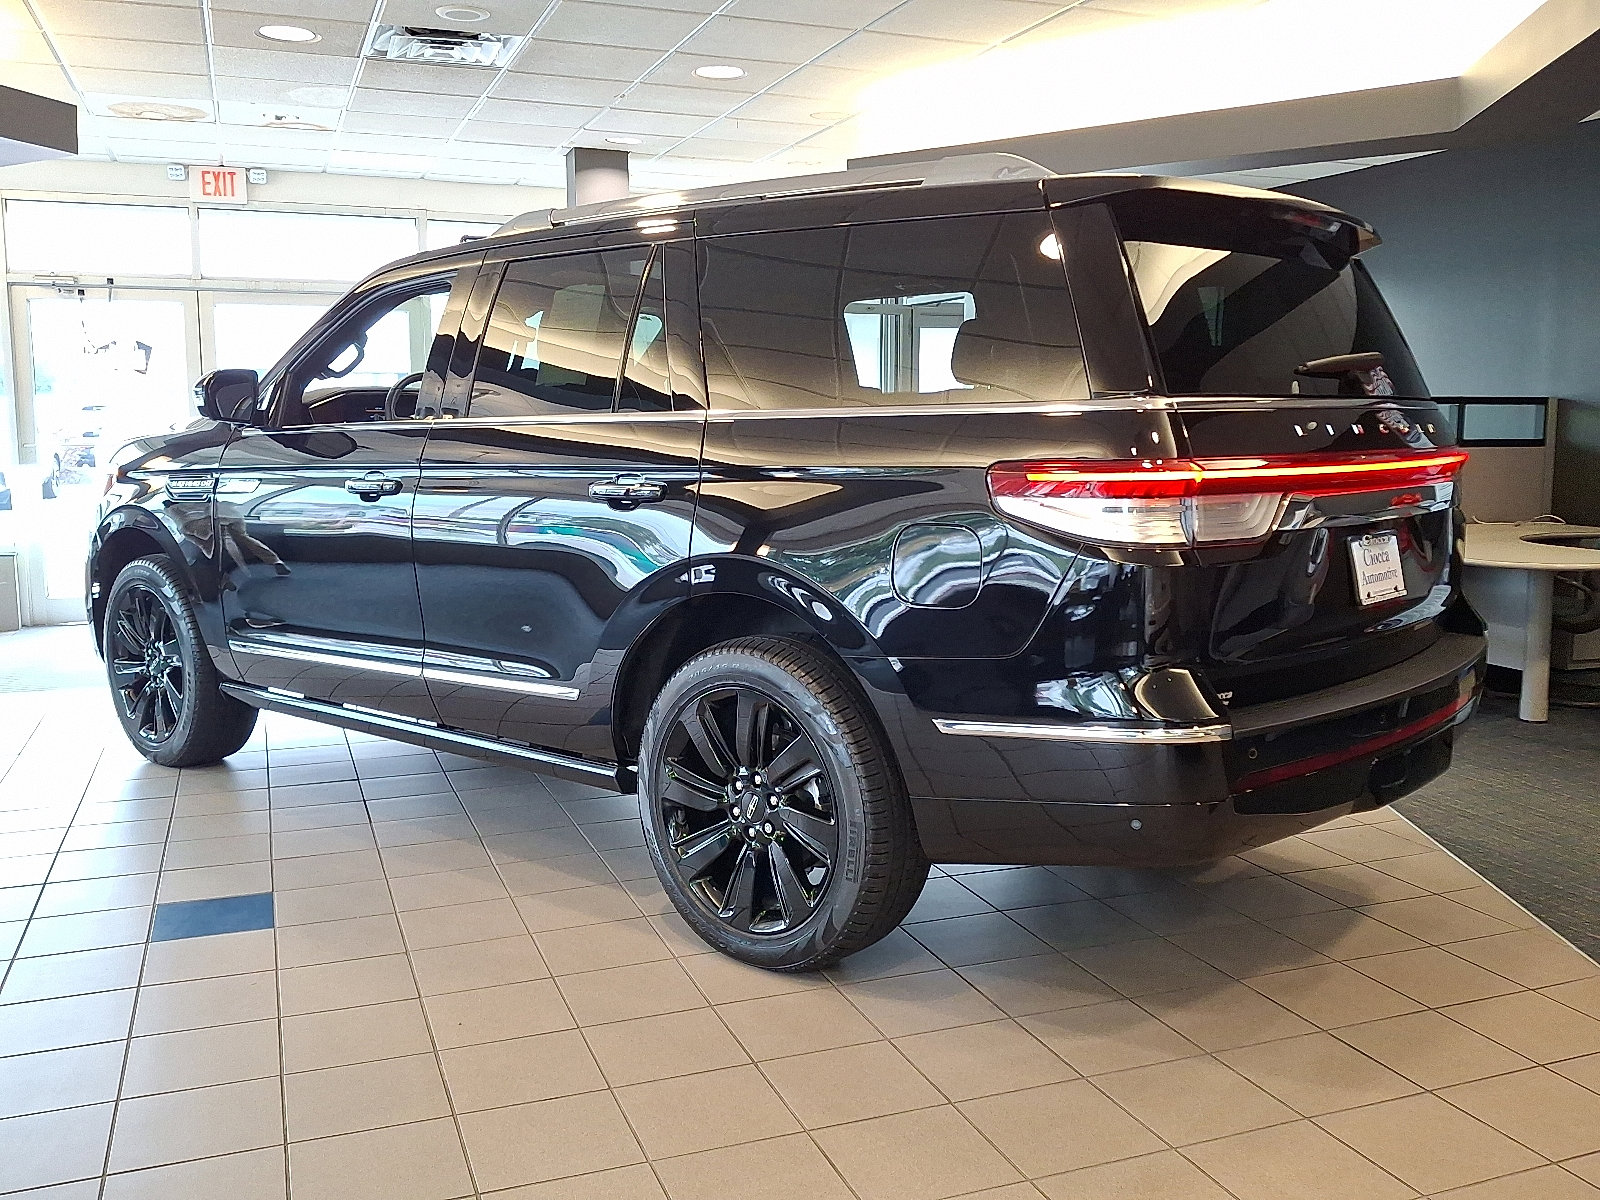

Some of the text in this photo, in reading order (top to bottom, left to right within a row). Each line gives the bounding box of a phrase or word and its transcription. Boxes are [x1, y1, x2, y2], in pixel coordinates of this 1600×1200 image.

[201, 170, 237, 197] EXIT
[1363, 548, 1391, 567] Ciocca
[1362, 567, 1398, 586] Automotive
